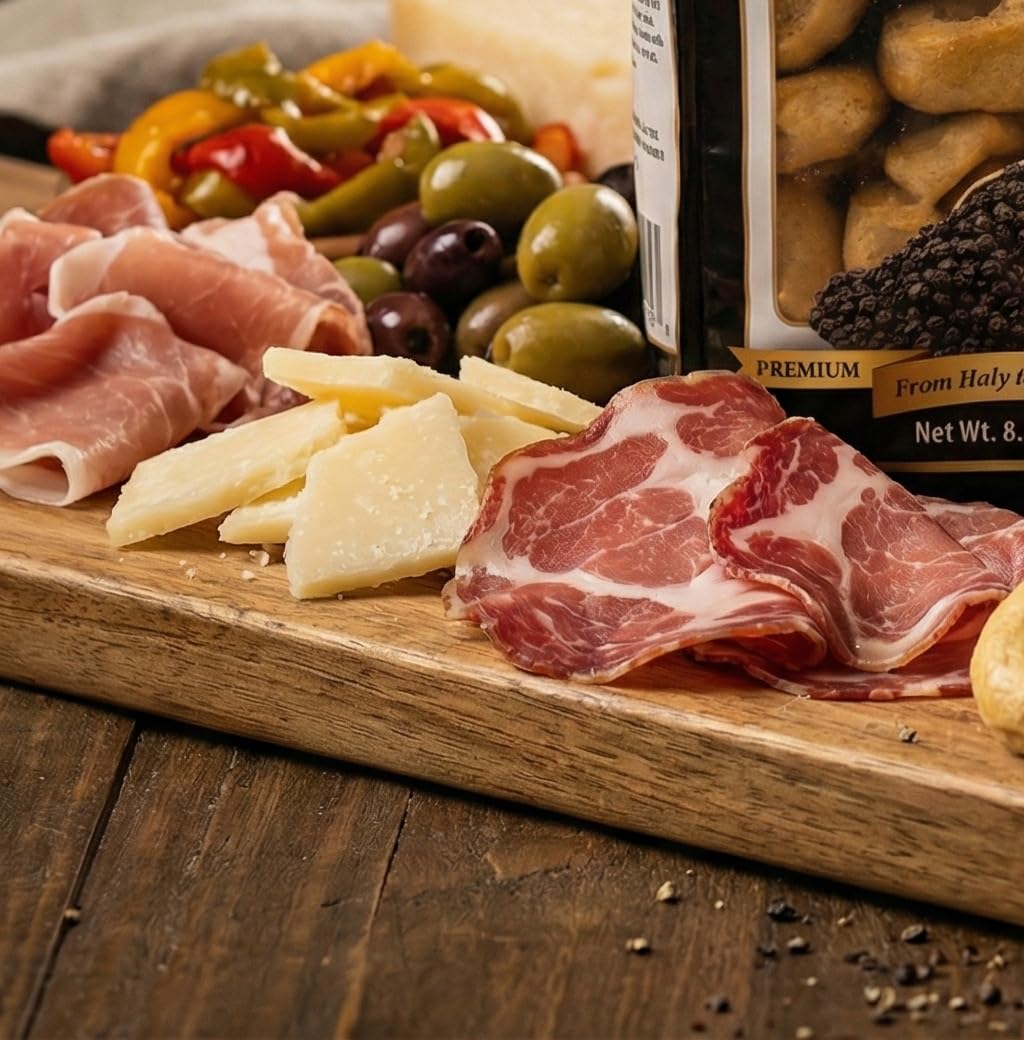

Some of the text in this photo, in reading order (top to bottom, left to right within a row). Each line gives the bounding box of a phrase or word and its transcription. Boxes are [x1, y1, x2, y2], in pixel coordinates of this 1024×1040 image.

[757, 360, 861, 379] PREMIUM
[896, 377, 952, 398] From
[915, 421, 954, 444] Net
[959, 420, 996, 443] Wt.
